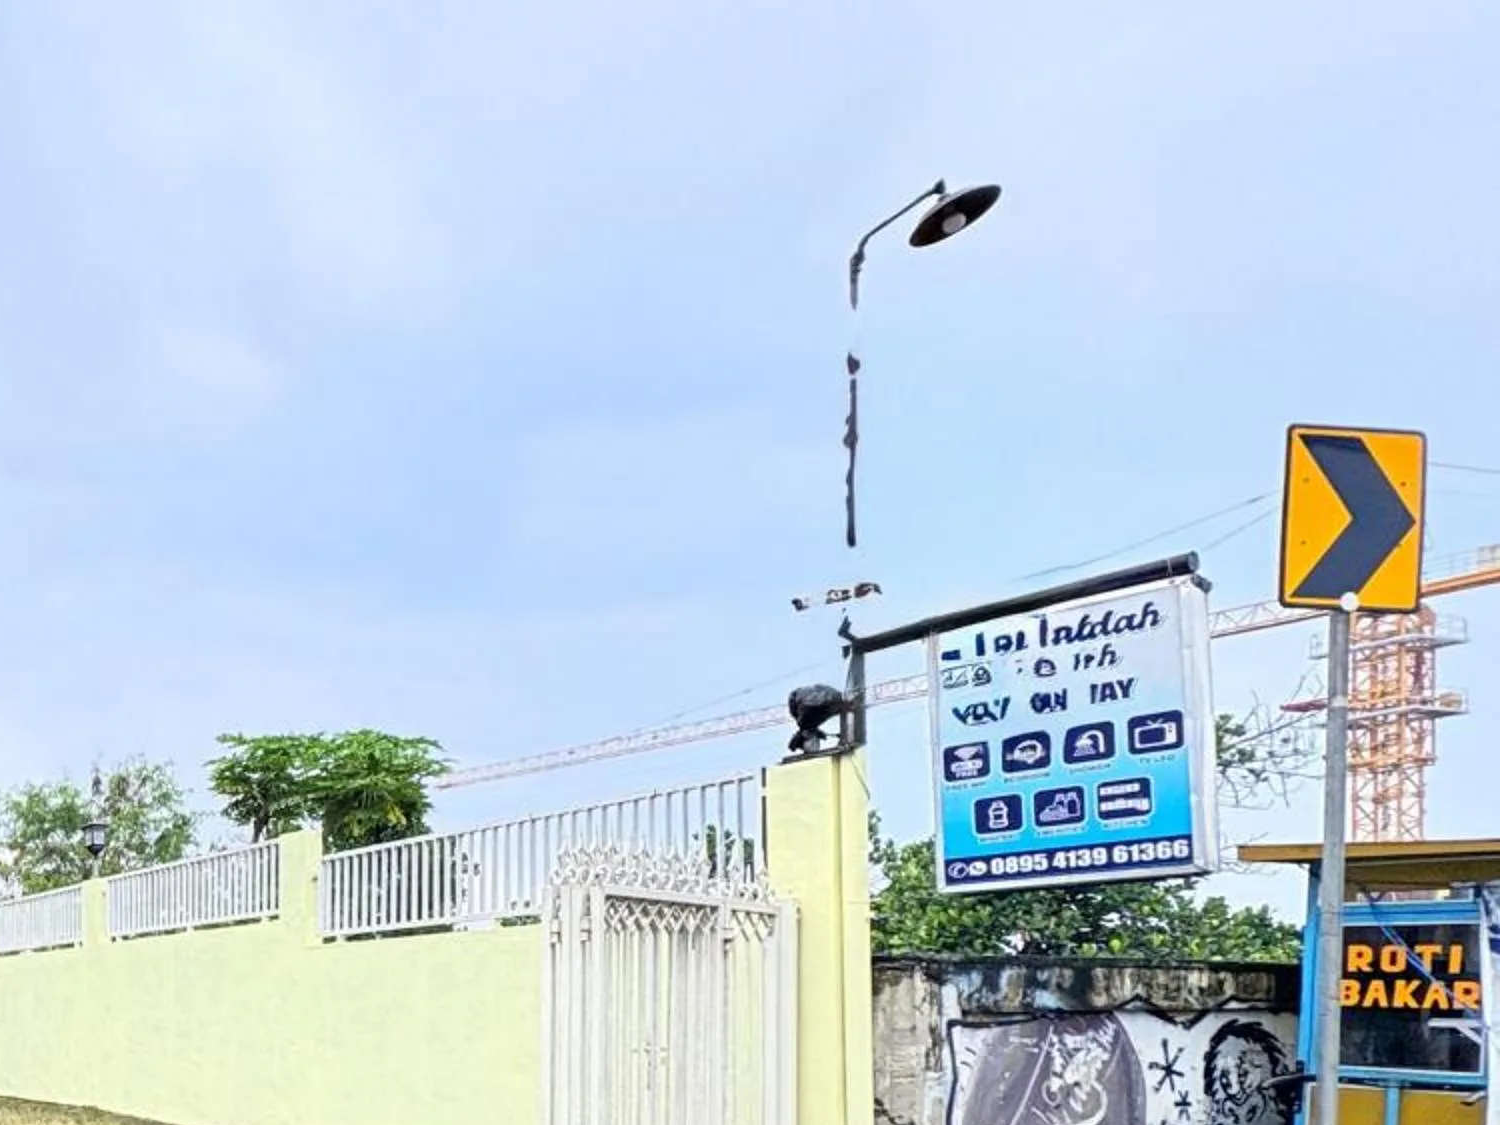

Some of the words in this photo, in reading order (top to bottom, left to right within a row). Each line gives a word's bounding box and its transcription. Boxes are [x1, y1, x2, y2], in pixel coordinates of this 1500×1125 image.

[990, 853, 1048, 875] 0895
[1052, 847, 1107, 869] 4139
[1112, 839, 1190, 864] 61366
[1347, 943, 1464, 974] ROTI
[1338, 978, 1481, 1010] BAKAR
